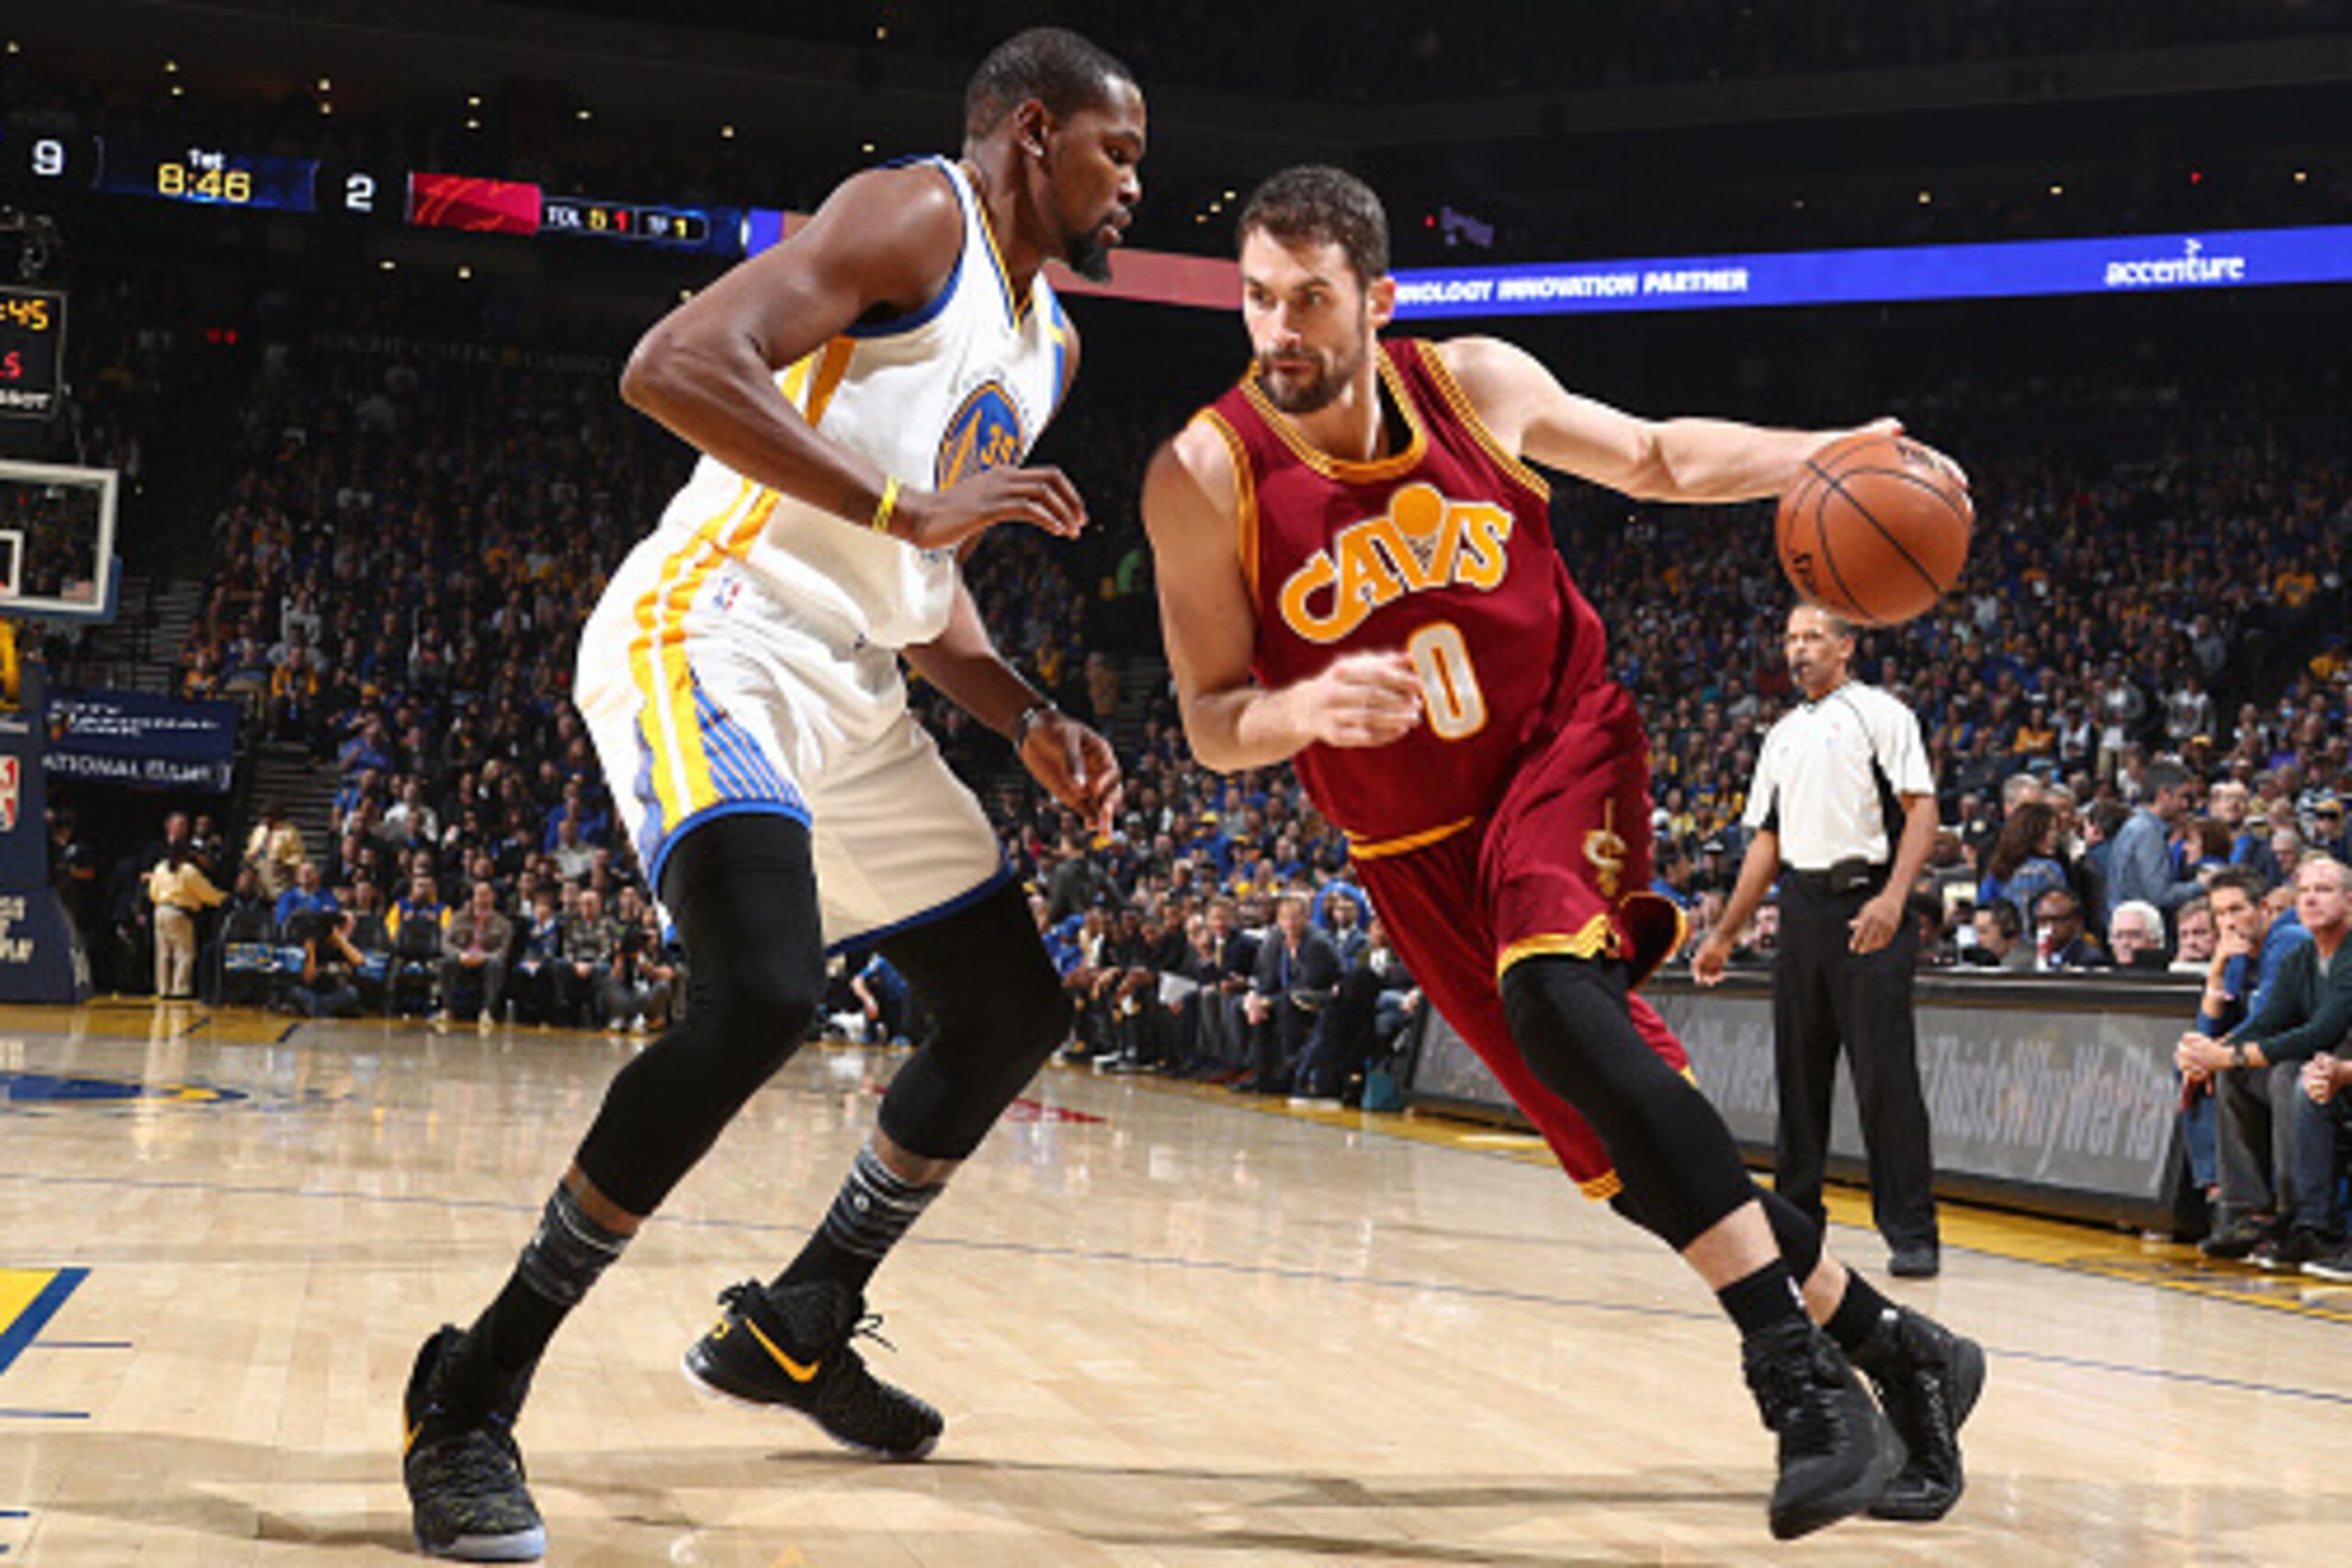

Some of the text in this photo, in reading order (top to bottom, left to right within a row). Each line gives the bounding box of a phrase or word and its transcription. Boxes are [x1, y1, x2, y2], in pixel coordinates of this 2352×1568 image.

[32, 140, 64, 175] 9
[158, 163, 251, 203] 8:46
[345, 175, 376, 211] 2
[2104, 238, 2245, 288] accenture
[1497, 273, 1639, 301] INNOVATION
[1643, 268, 1749, 295] PARTNER
[1279, 483, 1513, 643] CAVS
[1408, 621, 1487, 739] 0
